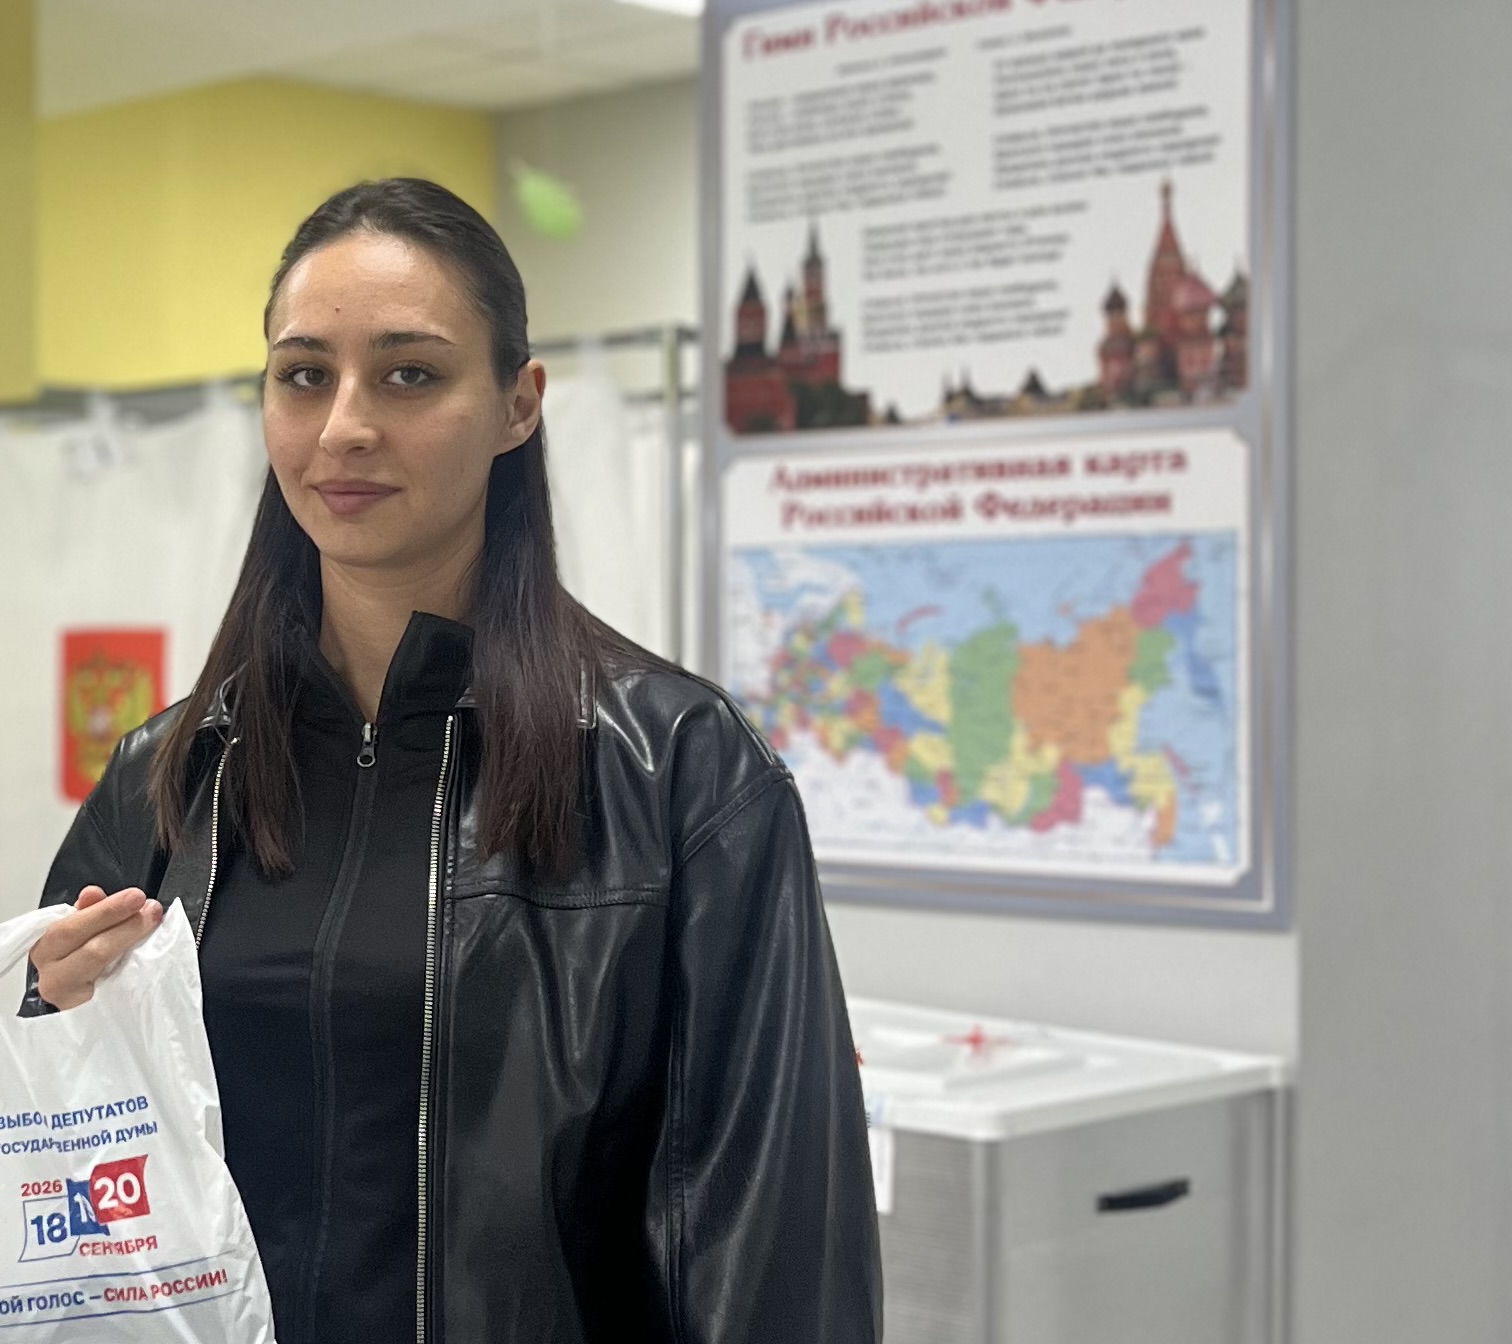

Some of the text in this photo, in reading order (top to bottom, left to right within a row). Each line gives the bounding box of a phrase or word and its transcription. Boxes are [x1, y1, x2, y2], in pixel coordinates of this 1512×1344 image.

[742, 29, 815, 61] Гимн
[770, 449, 1188, 492] Административная карта
[781, 489, 1172, 530] Российской Федерации
[51, 1096, 148, 1130] ДЕПУТАТОВ
[115, 1122, 158, 1143] ДУМЫ
[20, 1179, 63, 1197] 2026
[30, 1213, 68, 1245] 18
[94, 1172, 141, 1210] 20
[79, 1235, 158, 1257] СЕНЯБРЯ
[27, 1291, 85, 1312] ГОЛОС
[103, 1287, 149, 1303] СИЛА
[151, 1268, 229, 1299] РОССИИ!
